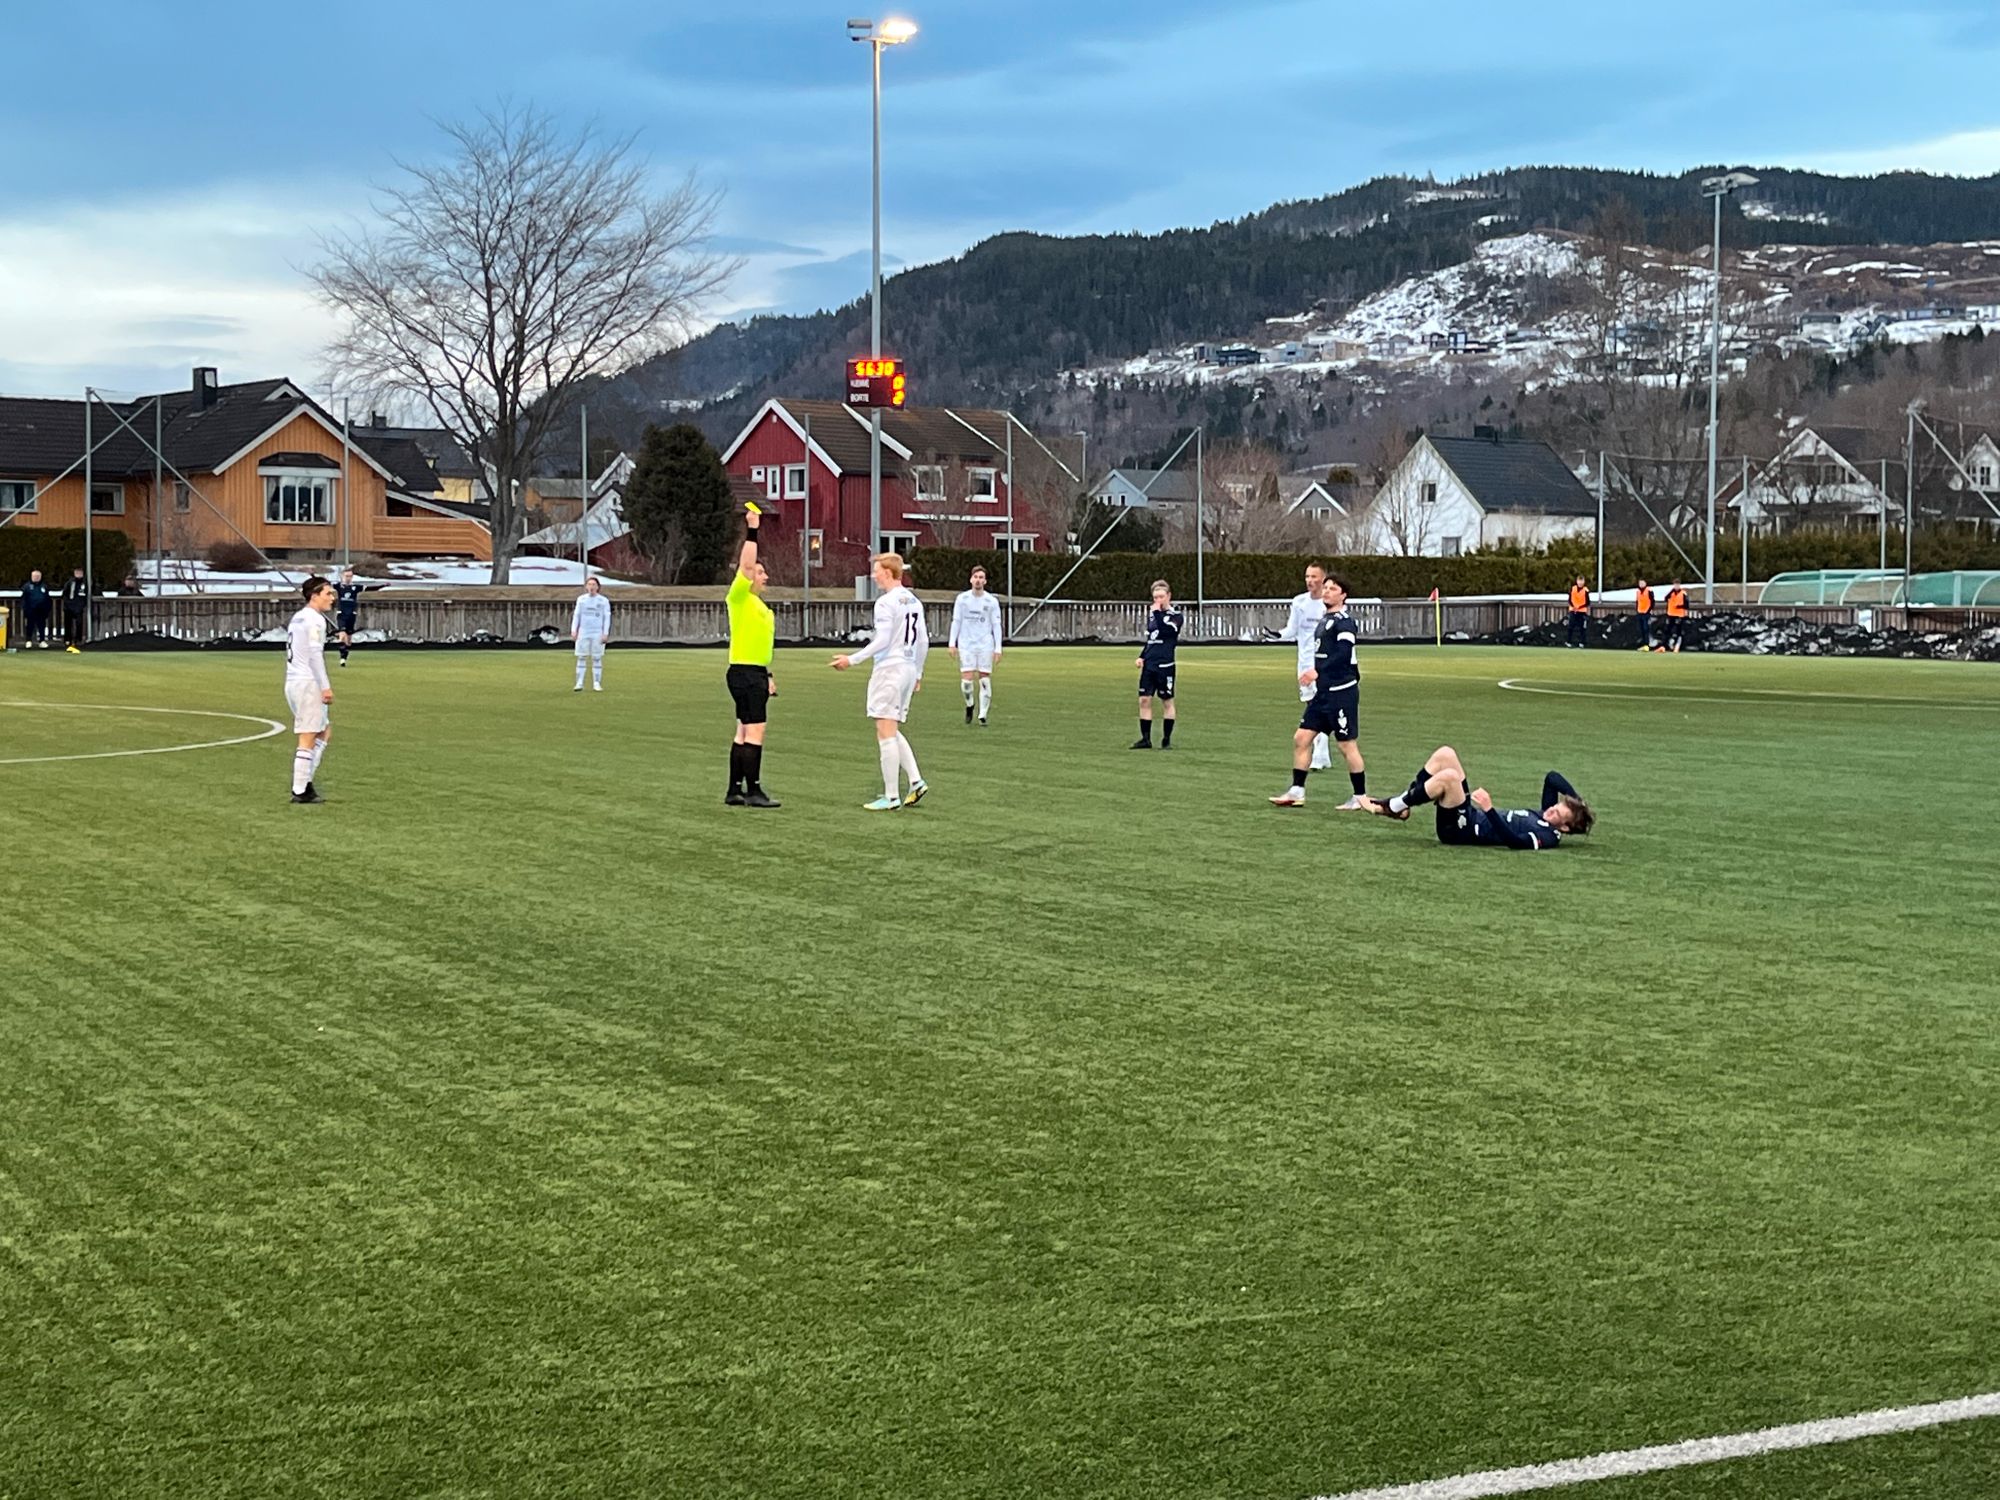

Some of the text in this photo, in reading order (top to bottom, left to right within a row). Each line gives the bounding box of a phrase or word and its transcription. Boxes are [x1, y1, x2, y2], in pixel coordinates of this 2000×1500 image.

[893, 375, 905, 390] 0
[892, 390, 905, 405] 2
[904, 612, 919, 646] 13
